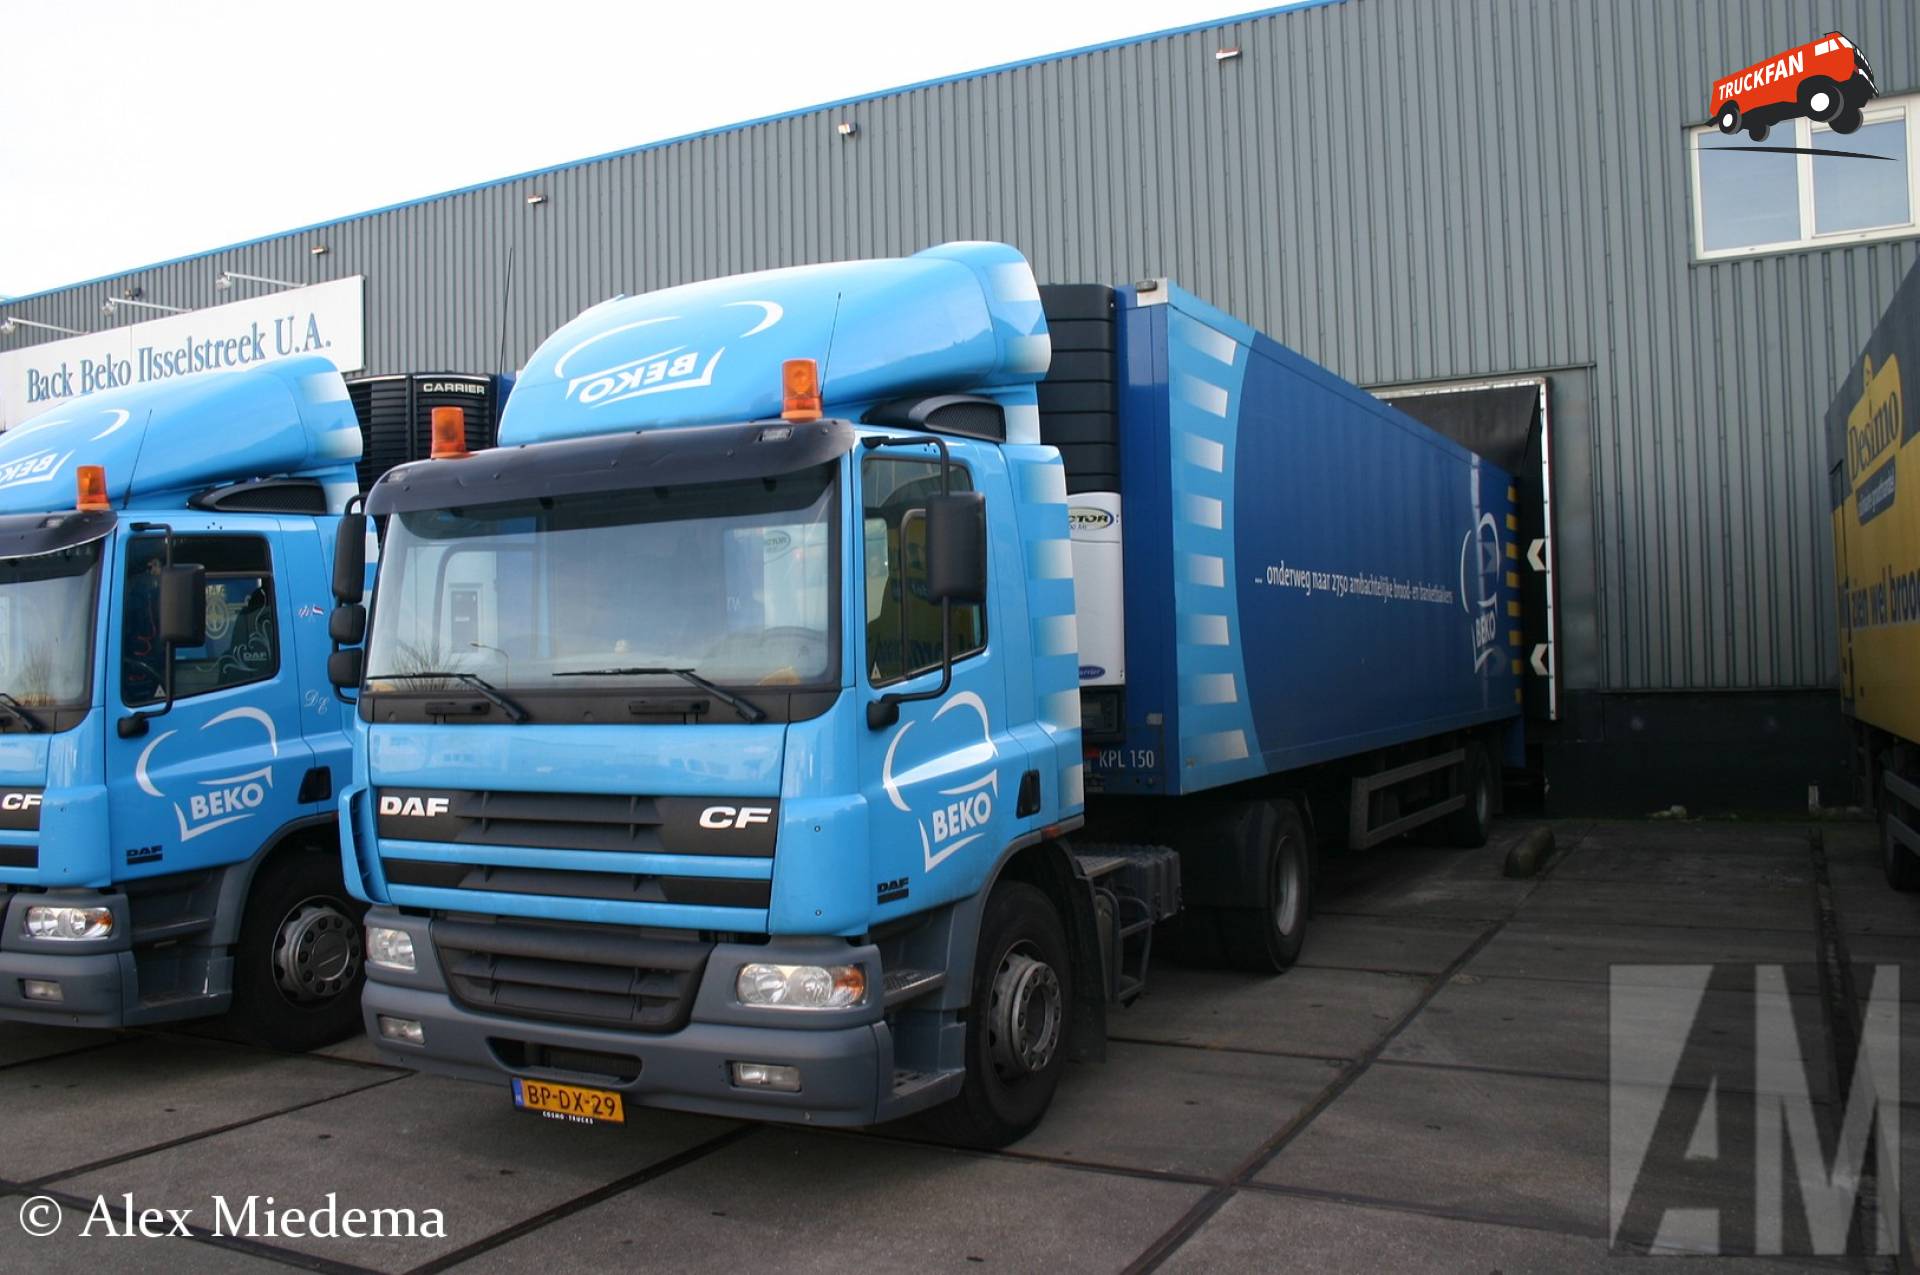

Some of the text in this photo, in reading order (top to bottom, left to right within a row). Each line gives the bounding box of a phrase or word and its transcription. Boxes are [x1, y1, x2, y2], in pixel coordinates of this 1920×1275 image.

[27, 364, 73, 403] Back
[80, 354, 132, 396] Beko
[275, 312, 332, 356] U.A.
[422, 382, 486, 395] CARRIER
[1848, 391, 1900, 481] Desimo
[1266, 560, 1311, 596] onderweg
[1312, 571, 1331, 591] naar
[1332, 574, 1348, 597] 2750
[1475, 612, 1496, 647] BEKO
[1099, 750, 1155, 768] KPL 150
[2, 794, 44, 810] CF
[190, 784, 264, 821] BEKO
[379, 796, 449, 817] DAF
[699, 806, 772, 829] CF
[932, 792, 993, 843] BEKO
[126, 846, 162, 857] DAF
[876, 877, 909, 891] DAF
[527, 1085, 615, 1117] BP-DX-29
